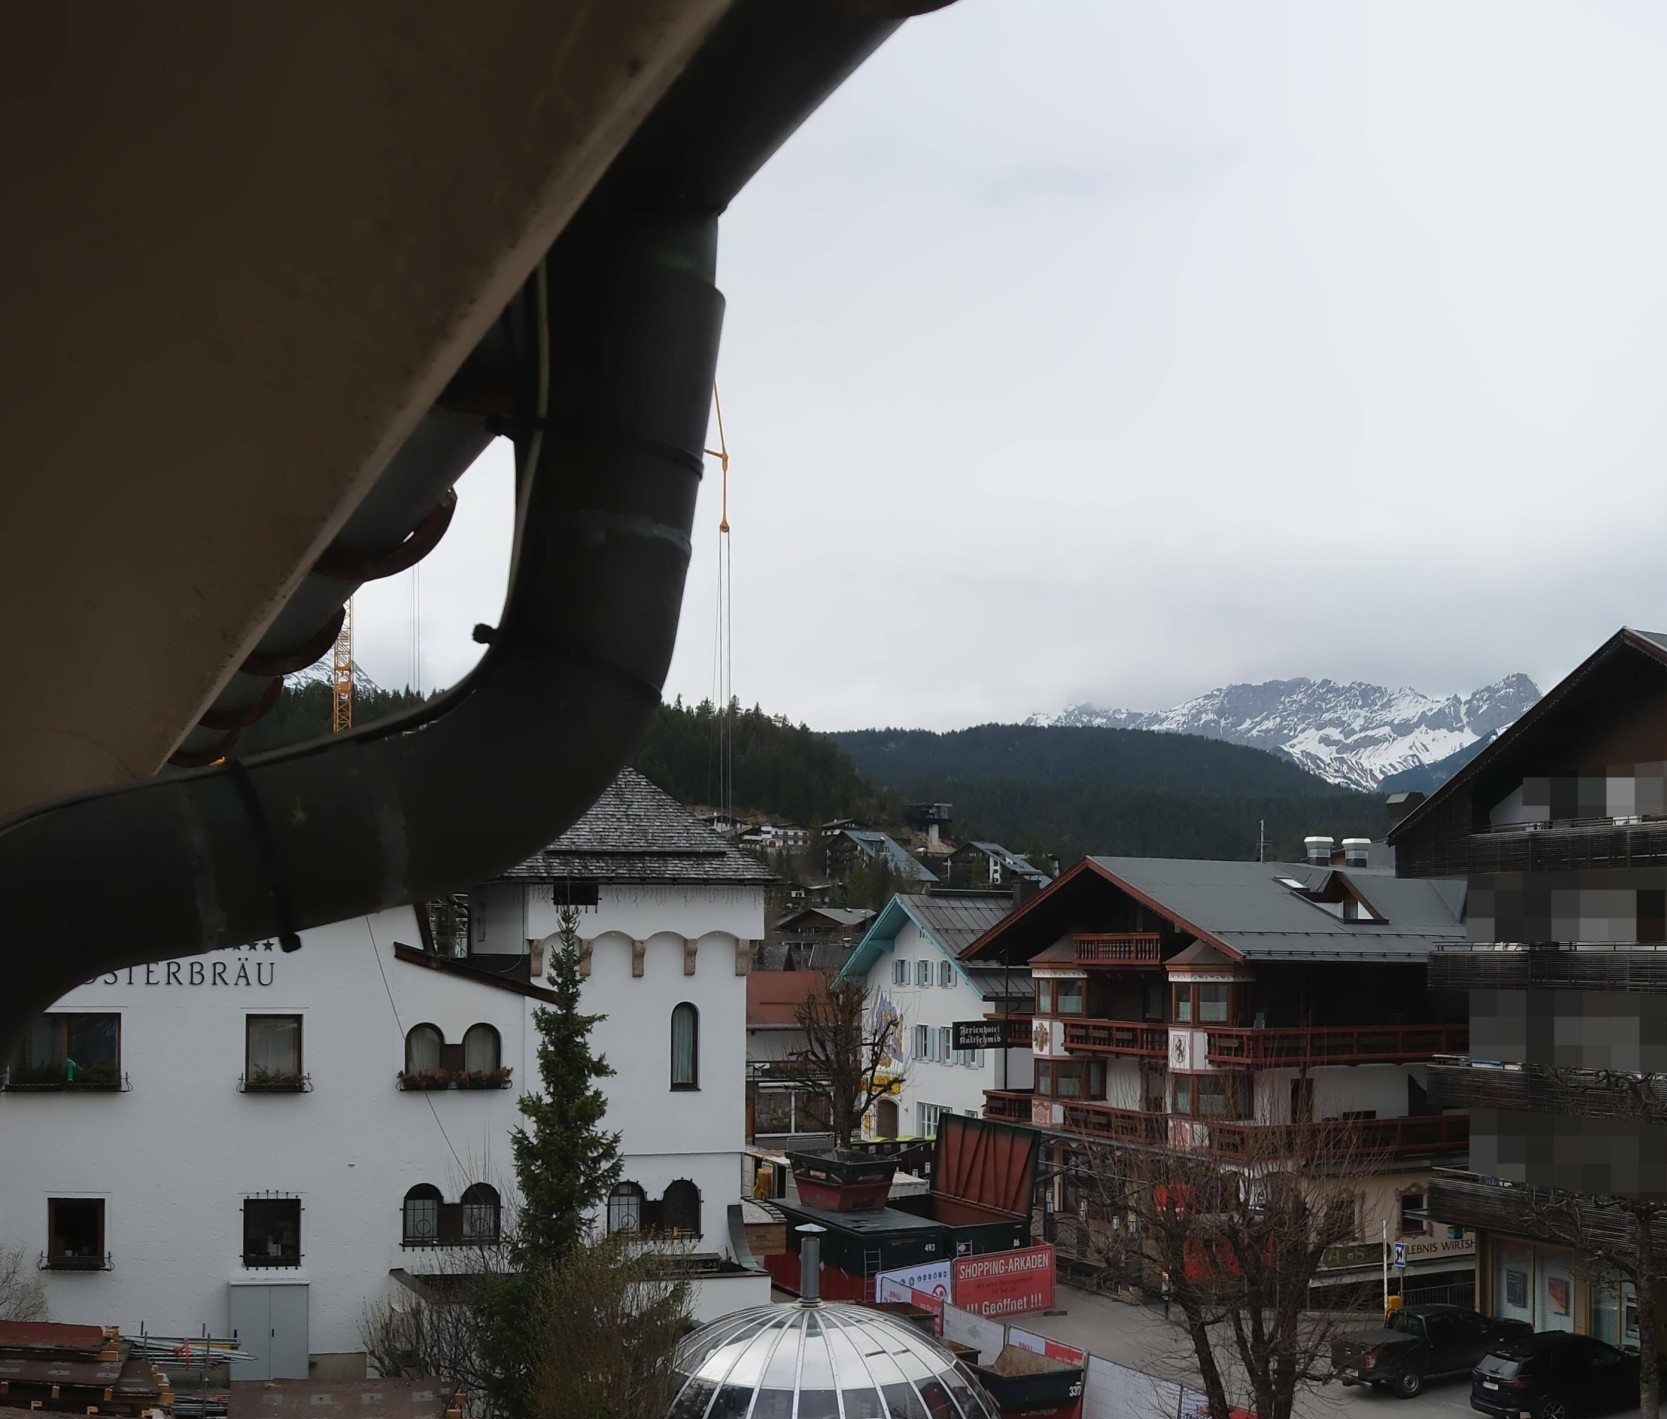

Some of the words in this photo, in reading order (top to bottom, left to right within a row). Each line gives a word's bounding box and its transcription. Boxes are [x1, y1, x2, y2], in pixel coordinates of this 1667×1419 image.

[84, 957, 275, 986] STERBRÄU
[925, 1244, 936, 1252] 493
[959, 1253, 1049, 1280] SHOPPING-ARKADEN
[982, 1296, 1027, 1315] Geöffnet
